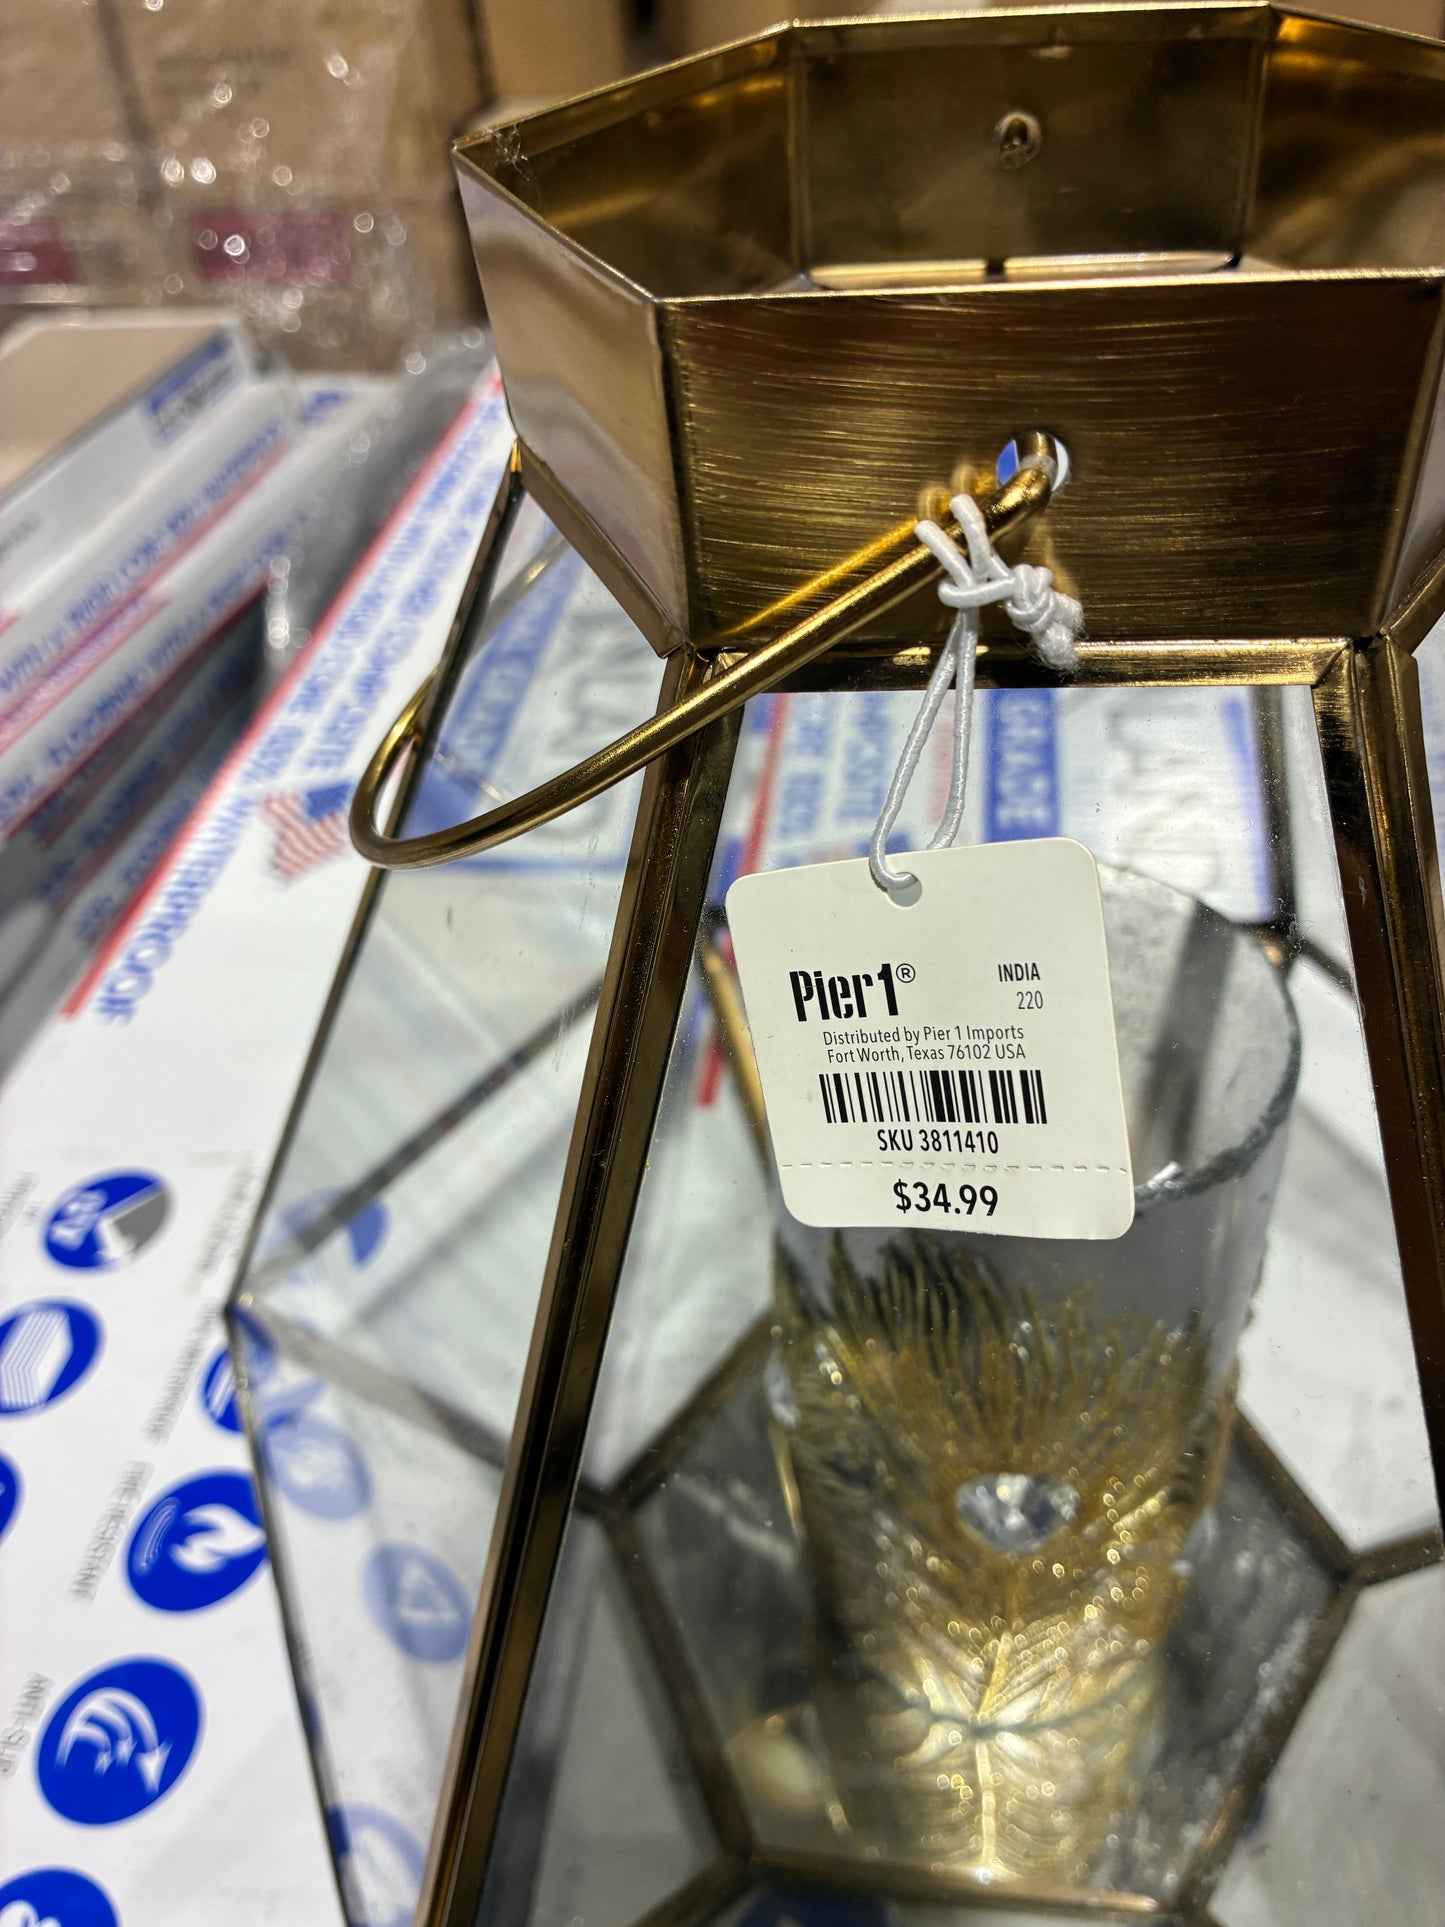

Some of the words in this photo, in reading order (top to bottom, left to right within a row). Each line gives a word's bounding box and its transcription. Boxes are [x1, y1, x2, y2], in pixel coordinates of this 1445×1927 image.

[997, 962, 1041, 983] INDIA
[1016, 990, 1044, 1010] 220
[823, 1028, 901, 1046] Distributed
[903, 1027, 920, 1046] by
[923, 1026, 951, 1042] Pier
[954, 1025, 962, 1041] 1
[966, 1025, 1025, 1044] Imports
[827, 1048, 855, 1064] Fort
[856, 1046, 904, 1064] Worth,
[906, 1045, 945, 1061] Texas
[949, 1044, 991, 1060] 76102
[995, 1044, 1026, 1059] USA
[877, 1129, 914, 1152] SKU
[918, 1129, 999, 1154] 3811410
[893, 1179, 999, 1217] $34.99
